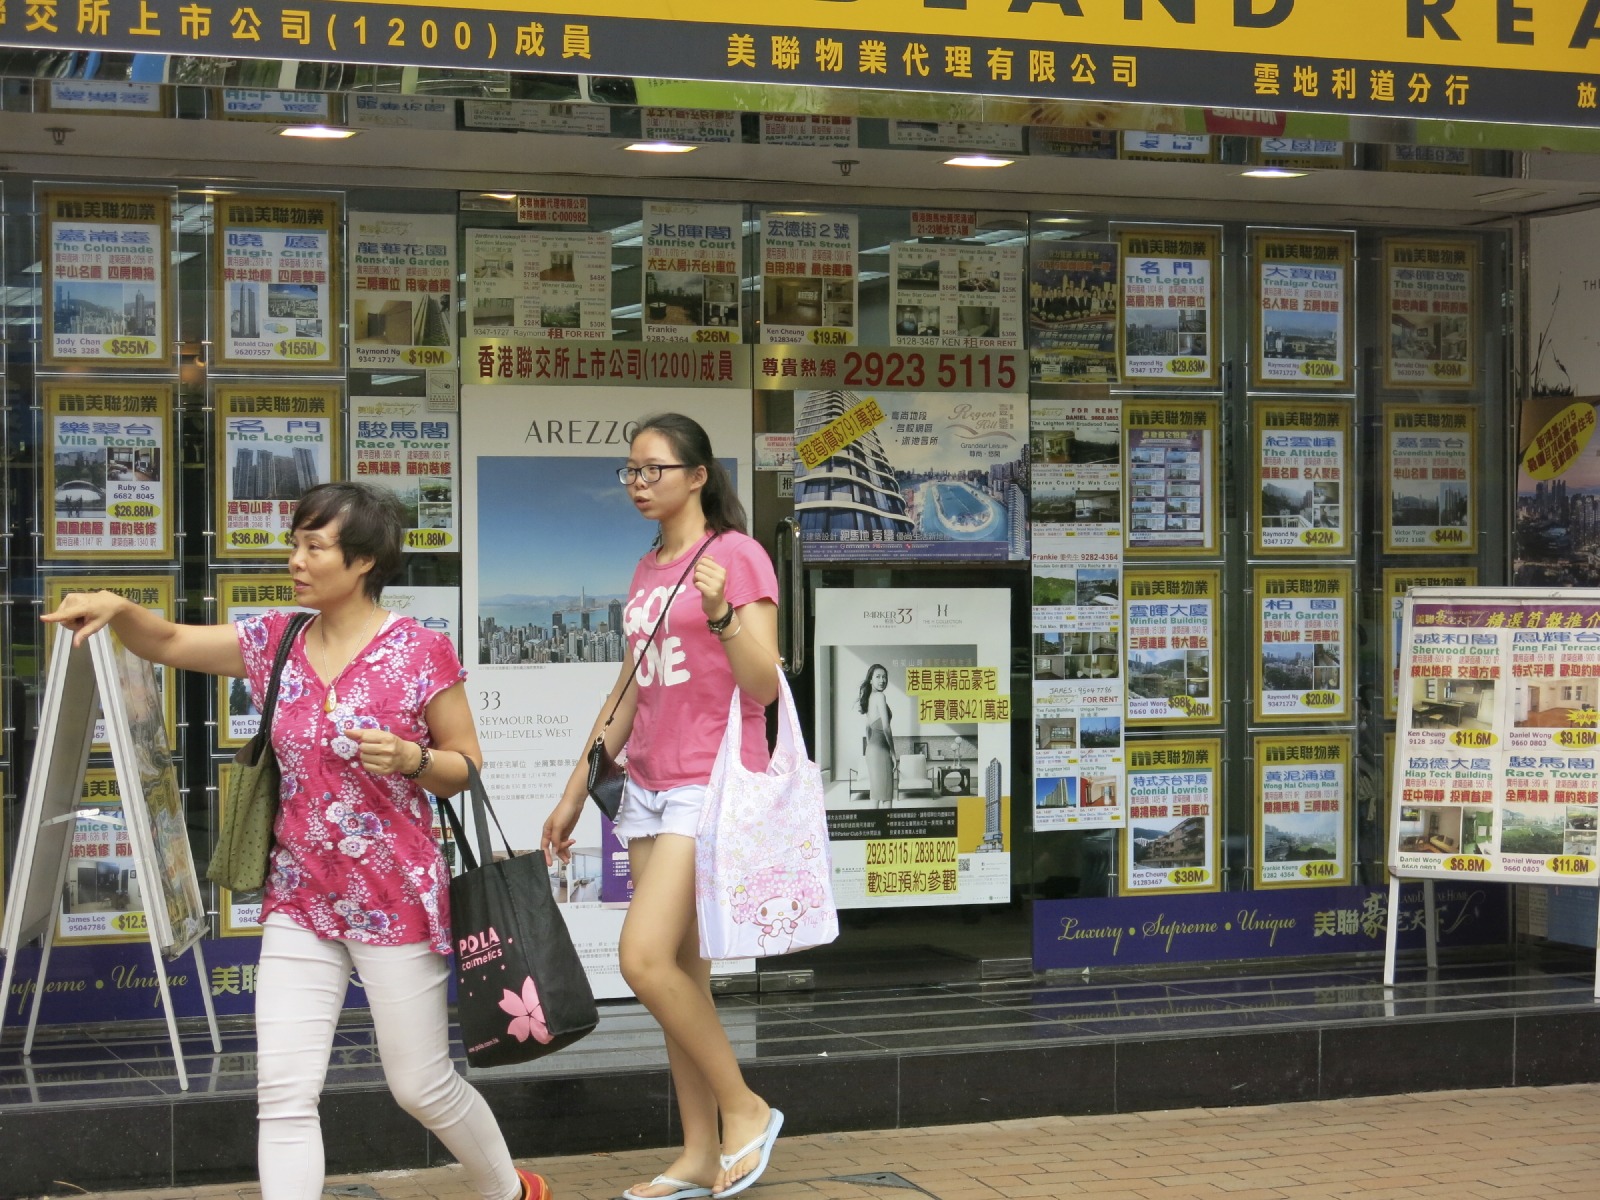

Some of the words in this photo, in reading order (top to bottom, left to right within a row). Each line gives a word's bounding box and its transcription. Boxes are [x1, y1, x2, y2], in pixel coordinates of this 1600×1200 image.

[0, 0, 592, 60] 交所上市公司(1200)成員
[727, 33, 1138, 88] 美聯物業代理有限公司
[1254, 63, 1470, 106] 雲地利道分行
[54, 243, 81, 251] The
[84, 244, 153, 254] Colonnade
[647, 237, 695, 248] Sunrise
[699, 239, 736, 249] Court
[765, 239, 794, 248] Wang
[819, 241, 851, 249] Street
[355, 255, 405, 266] Ronsdale
[409, 257, 449, 266] Garden
[1126, 275, 1151, 284] The
[1156, 276, 1205, 286] Legend
[1263, 278, 1308, 288] Trafalgar
[1311, 281, 1339, 289] Court
[1394, 279, 1413, 289] The
[1416, 281, 1466, 293] Signature
[513, 329, 546, 337] Raymond
[565, 330, 582, 338] FOR
[647, 325, 677, 334] Frankie
[780, 328, 805, 336] Cheung
[56, 337, 75, 347] Jody
[79, 338, 101, 346] Chan
[695, 331, 730, 343] $26M
[813, 331, 847, 345] $19.5M
[896, 337, 939, 346] 9128-3467
[942, 338, 960, 346] KEN
[979, 339, 995, 347] FOR
[111, 340, 149, 356] $55M
[280, 341, 317, 356] $155M
[356, 348, 388, 356] Raymond
[391, 349, 400, 357] Ng
[408, 350, 445, 364] $19M
[478, 344, 734, 382] 香港聯交所上市公司(1200)成員
[761, 357, 837, 379] 尊貴熱線
[844, 352, 926, 388] 2923
[938, 354, 1016, 389] 5115
[1172, 359, 1205, 373] $29.83M
[1305, 363, 1334, 376] $120M
[86, 395, 157, 413] 美聯物業
[256, 396, 325, 413] 美聯物業
[1150, 410, 1207, 425] 美聯物業
[58, 435, 97, 446] Villa
[103, 436, 157, 447] Rocha
[227, 432, 258, 441] The
[264, 433, 324, 444] Legend
[355, 440, 395, 450] Race
[400, 440, 450, 449] Tower
[1263, 448, 1286, 457] The
[1289, 449, 1338, 458] Altitude
[1392, 449, 1433, 457] Cavendish
[1435, 450, 1466, 458] Heights
[117, 483, 137, 493] Ruby
[140, 484, 150, 492] So
[113, 492, 132, 500] 6682
[136, 492, 155, 500] 8045
[114, 504, 154, 518] $26.88M
[231, 531, 269, 546] $36.8M
[409, 531, 446, 547] $11.88M
[1305, 530, 1334, 544] $42M
[1435, 529, 1463, 543] $44M
[1032, 553, 1058, 561] Frankie
[1081, 553, 1119, 561] 9282-4364
[1151, 580, 1209, 595] 美聯物業
[1286, 579, 1340, 593] 美聯物業
[623, 584, 687, 637] GOT
[895, 608, 913, 624] 33
[1264, 611, 1291, 620] Park
[1295, 611, 1339, 620] Garden
[1129, 617, 1168, 625] Winfield
[1170, 617, 1208, 626] Building
[1412, 645, 1466, 655] Sherwood
[1469, 646, 1500, 655] Court
[1512, 643, 1538, 652] Fung
[633, 636, 691, 688] ONE
[907, 668, 998, 692] 港島東精品豪宅
[480, 691, 501, 711] 33
[1305, 693, 1335, 706] $20.8M
[480, 715, 533, 726] SEYMOUR
[536, 715, 569, 724] ROAD
[480, 729, 542, 739] MID-LEVELS
[545, 728, 574, 737] WEST
[1421, 730, 1446, 738] Cheung
[1455, 731, 1491, 746] $11.6M
[1560, 730, 1597, 745] $9.18M
[1152, 750, 1209, 765] 美聯物業
[1405, 770, 1426, 779] Hiap
[1429, 770, 1452, 778] Teck
[1455, 770, 1493, 780] Building
[1505, 769, 1544, 778] Race
[1550, 769, 1599, 779] Tower
[1130, 786, 1169, 795] Colonial
[1171, 786, 1209, 795] Lowrise
[1263, 782, 1283, 790] Wong
[1298, 781, 1320, 790] Chung
[866, 842, 887, 865] 2923
[889, 841, 909, 864] 5115
[914, 840, 935, 863] 2838
[936, 840, 957, 863] 8202
[1305, 863, 1334, 878] $14M
[1450, 858, 1485, 872] $6.8M
[1552, 859, 1589, 873] $11.8M
[867, 868, 958, 895] 歡迎預約參觀
[1174, 870, 1204, 884] $38M
[67, 916, 90, 924] James
[69, 923, 106, 932] 95047786
[1058, 917, 1124, 956] Luxury
[1142, 912, 1218, 953] Supreme
[1237, 908, 1297, 948] Unique
[459, 926, 501, 956] POLA
[461, 948, 503, 972] cosmetics
